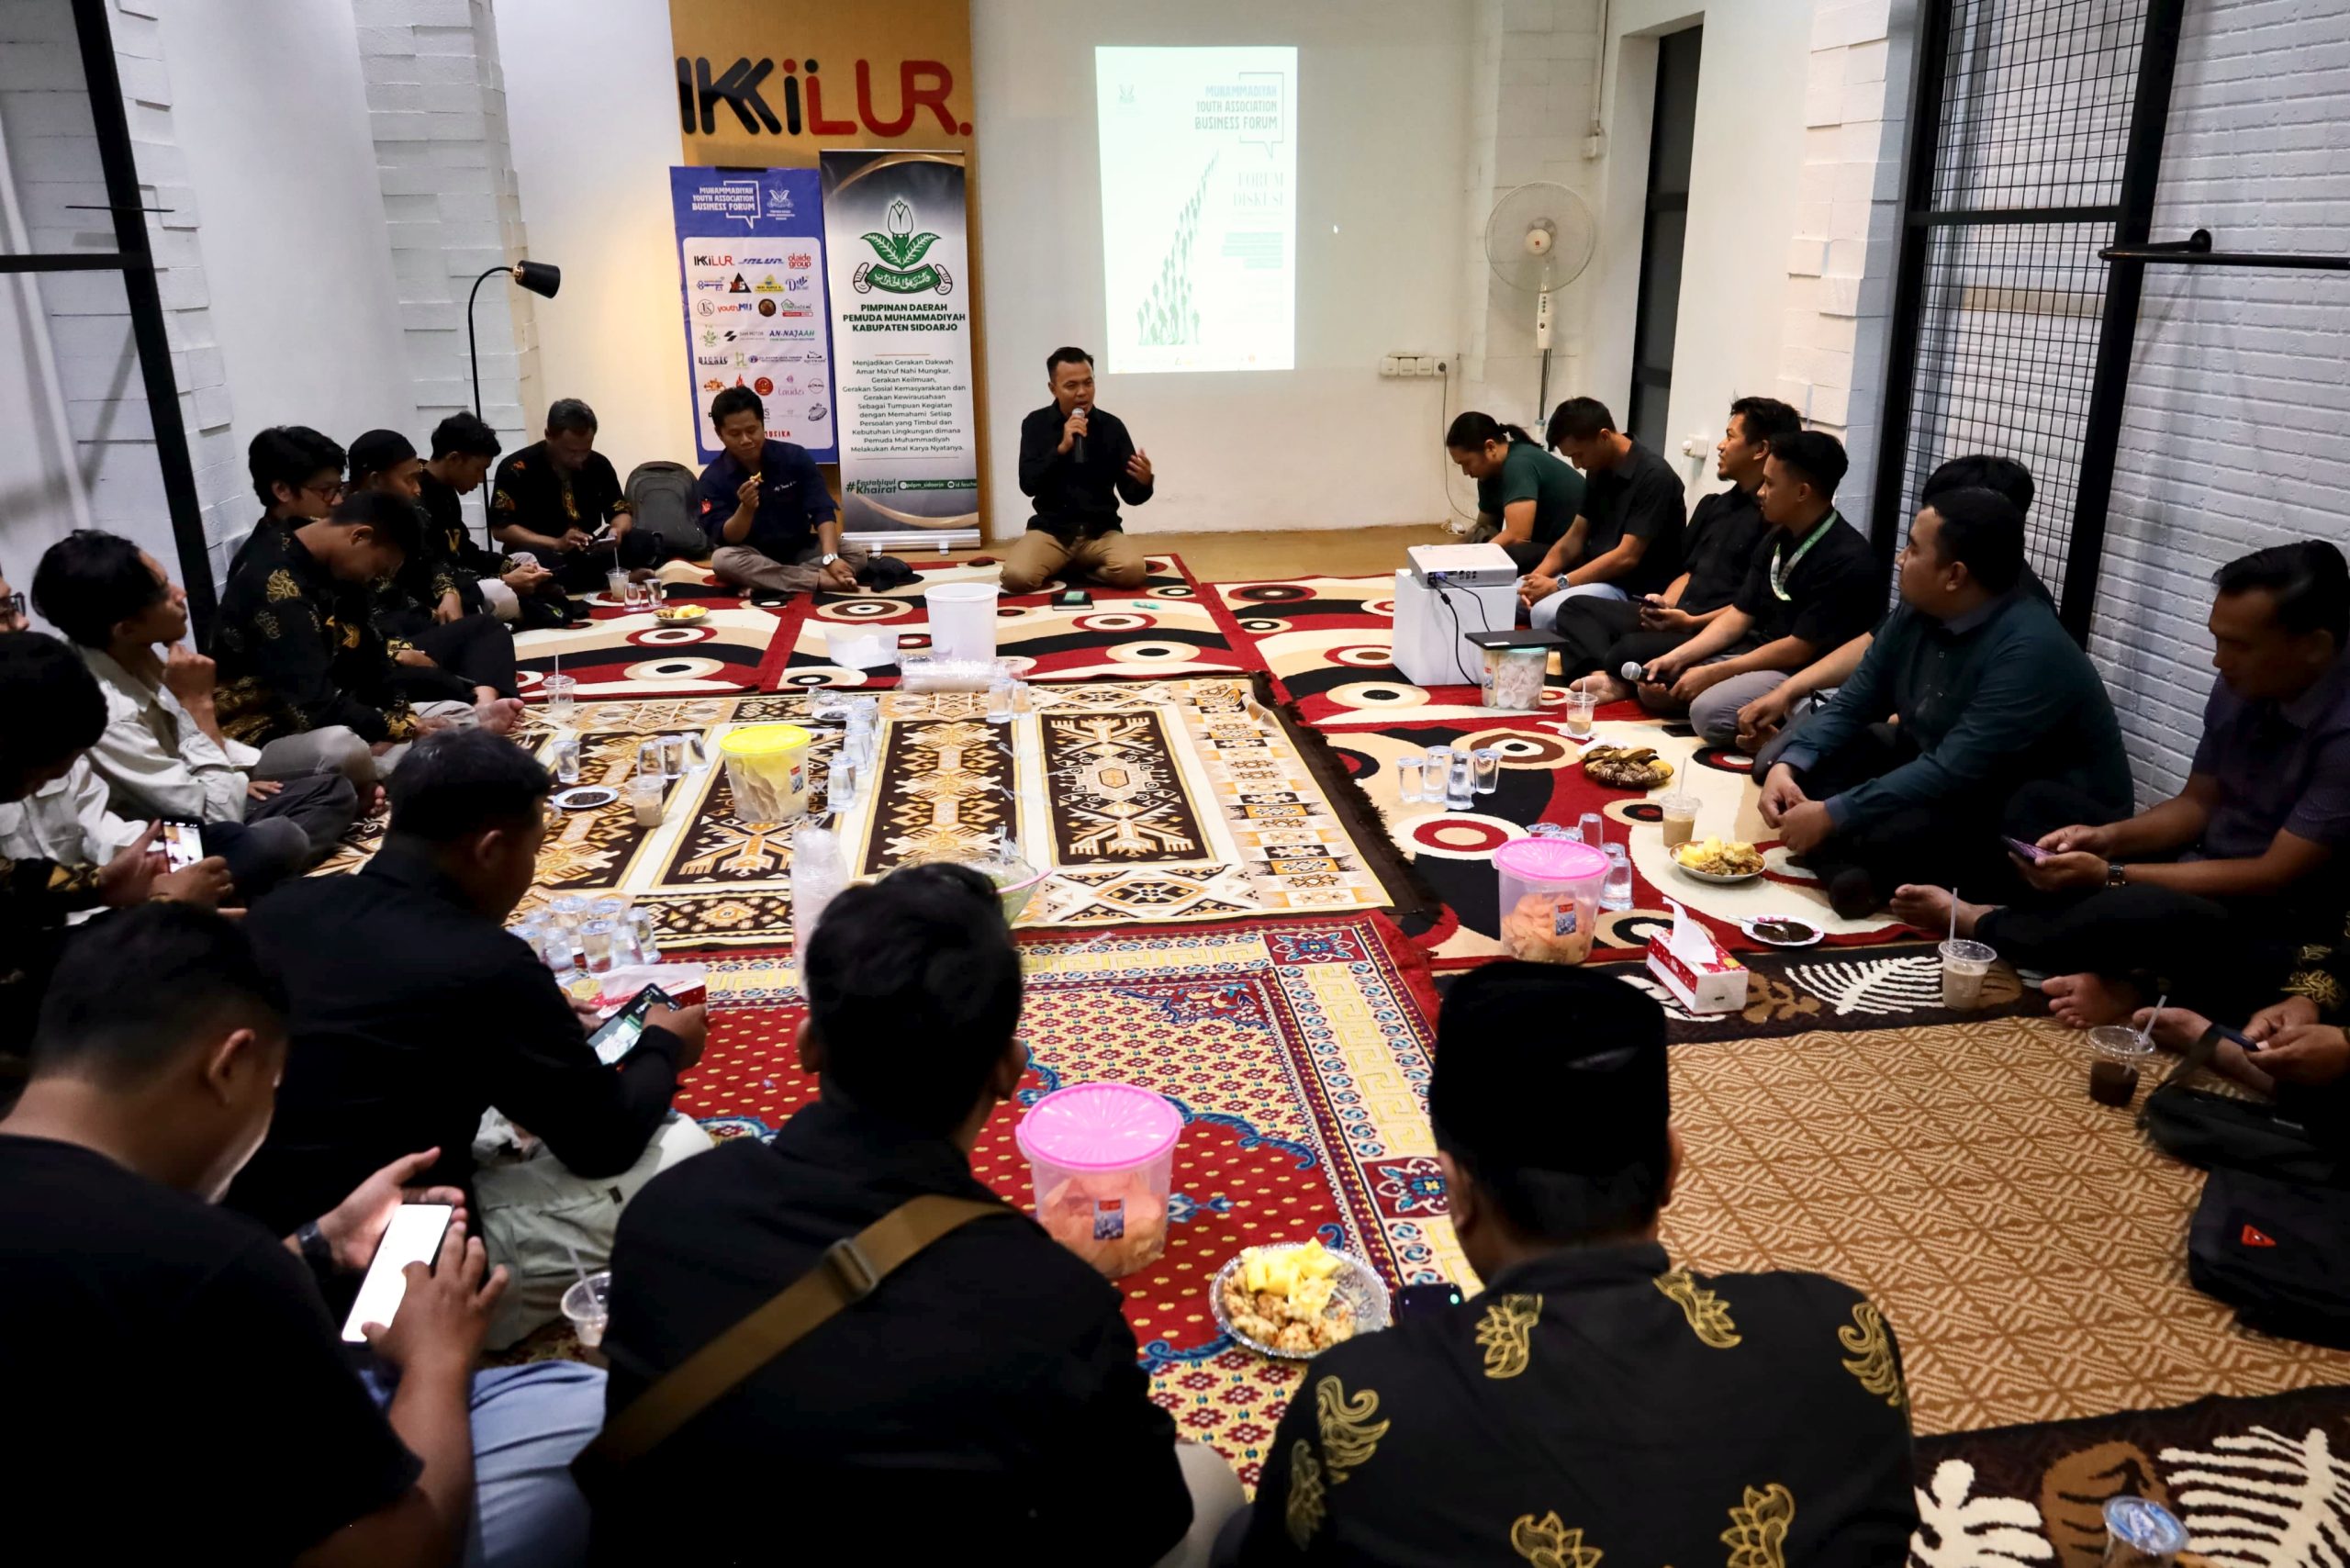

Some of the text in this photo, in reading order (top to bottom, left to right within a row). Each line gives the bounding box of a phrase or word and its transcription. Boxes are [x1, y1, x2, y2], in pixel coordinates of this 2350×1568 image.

[1205, 85, 1277, 97] MUHAMMADIYAH
[1196, 100, 1277, 113] YOUTH ASSOCIATION
[1195, 116, 1277, 129] BUSINESS FORUM
[861, 303, 947, 312] PIMPINAN DAERAH
[884, 313, 966, 321] MUHAMMADIYAH
[852, 323, 957, 332] KABUPATEN SIDOARJO
[856, 486, 897, 494] Khairat
